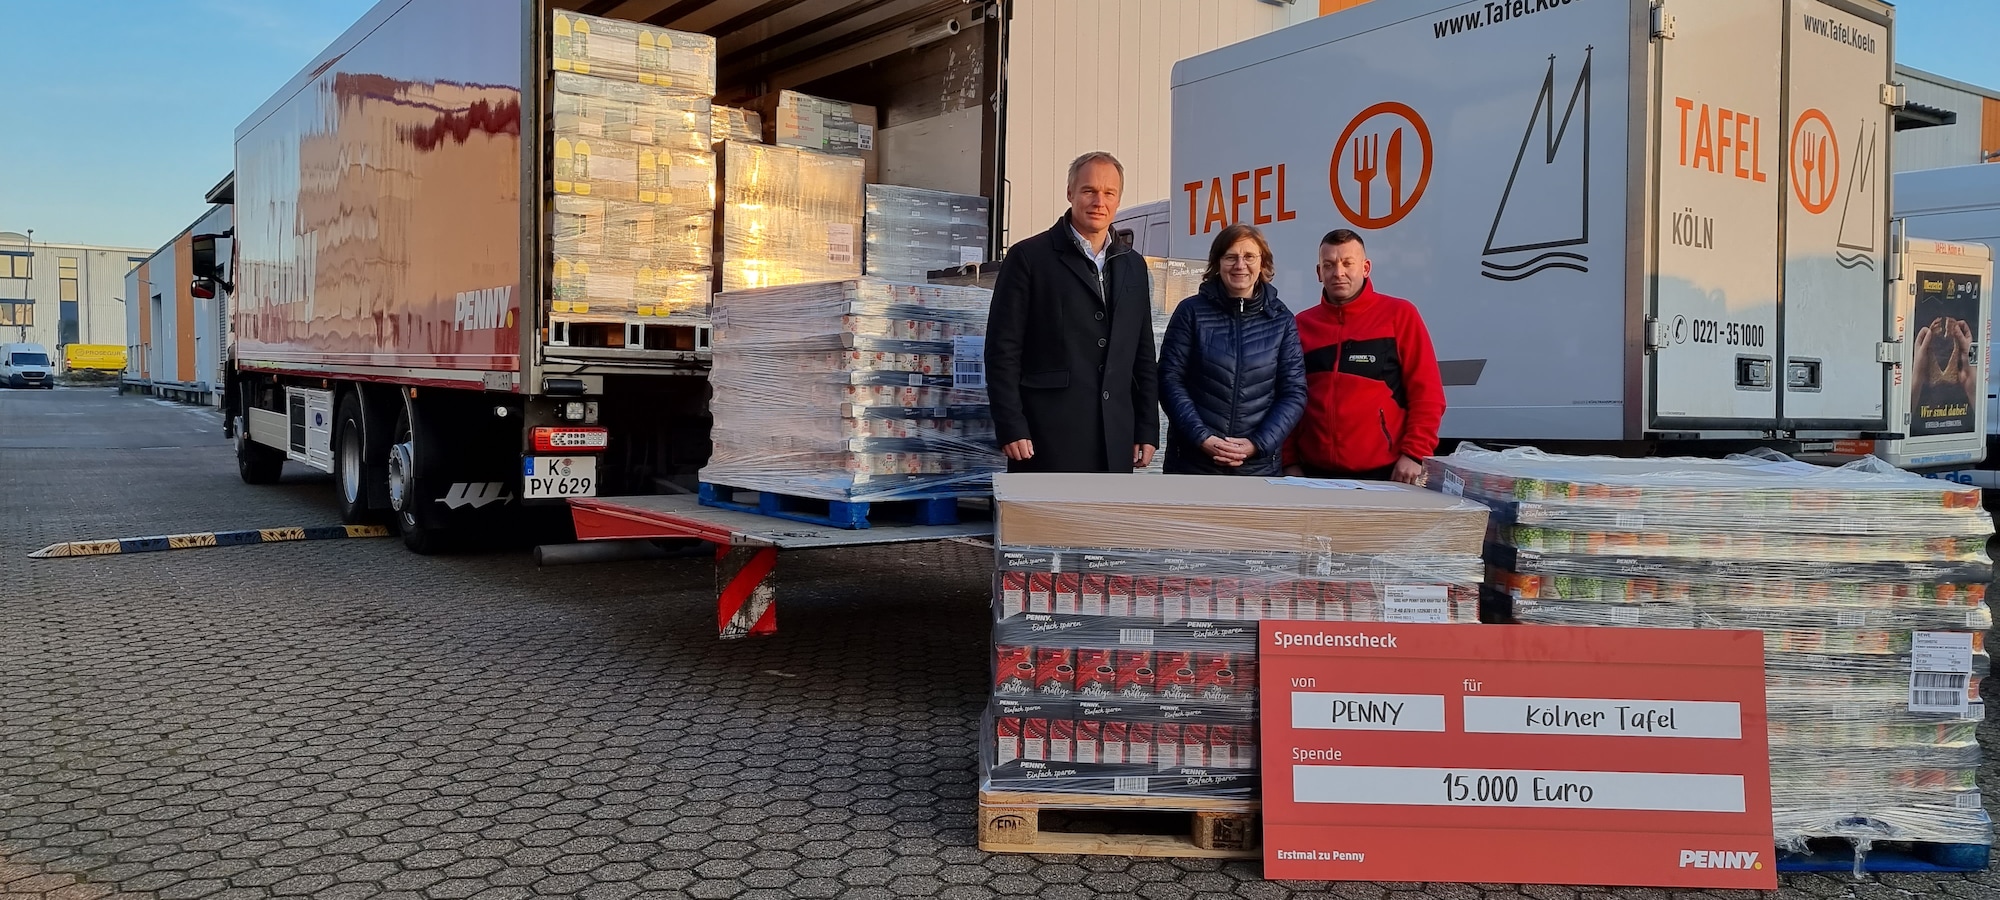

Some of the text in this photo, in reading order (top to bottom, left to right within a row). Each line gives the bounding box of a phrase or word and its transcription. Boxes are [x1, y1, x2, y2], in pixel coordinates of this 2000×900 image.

[1803, 14, 1876, 54] www.Tafel.Koeln
[1675, 96, 1767, 183] TAFEL
[1184, 163, 1297, 237] TAFEL
[1672, 207, 1714, 250] KÖLN
[454, 285, 514, 332] PENNY.
[1692, 319, 1765, 348] 0221-351000
[1920, 403, 1968, 418] Wir sind dabei!
[549, 459, 560, 476] K
[530, 477, 591, 496] PY 629
[1025, 613, 1052, 622] PENNY.
[1187, 621, 1214, 629] PENNY.
[1031, 621, 1082, 632] Einfach sparen
[1193, 627, 1244, 639] Einfach sparen
[1274, 631, 1397, 649] Spendenscheck
[1291, 677, 1316, 688] von
[1463, 678, 1483, 692] für
[1331, 699, 1404, 725] PENNY
[1525, 704, 1679, 731] Kölner Tafel
[1292, 746, 1342, 761] Spende
[1020, 761, 1046, 769] PENNY.
[1181, 768, 1207, 776] PENNY.
[1026, 768, 1076, 780] Einfach sparen
[1186, 775, 1237, 786] Einfach sparen
[1442, 772, 1594, 803] 15.000 Euro
[1277, 849, 1365, 865] Erstmal zu Penny
[1679, 849, 1763, 870] PENNY.
